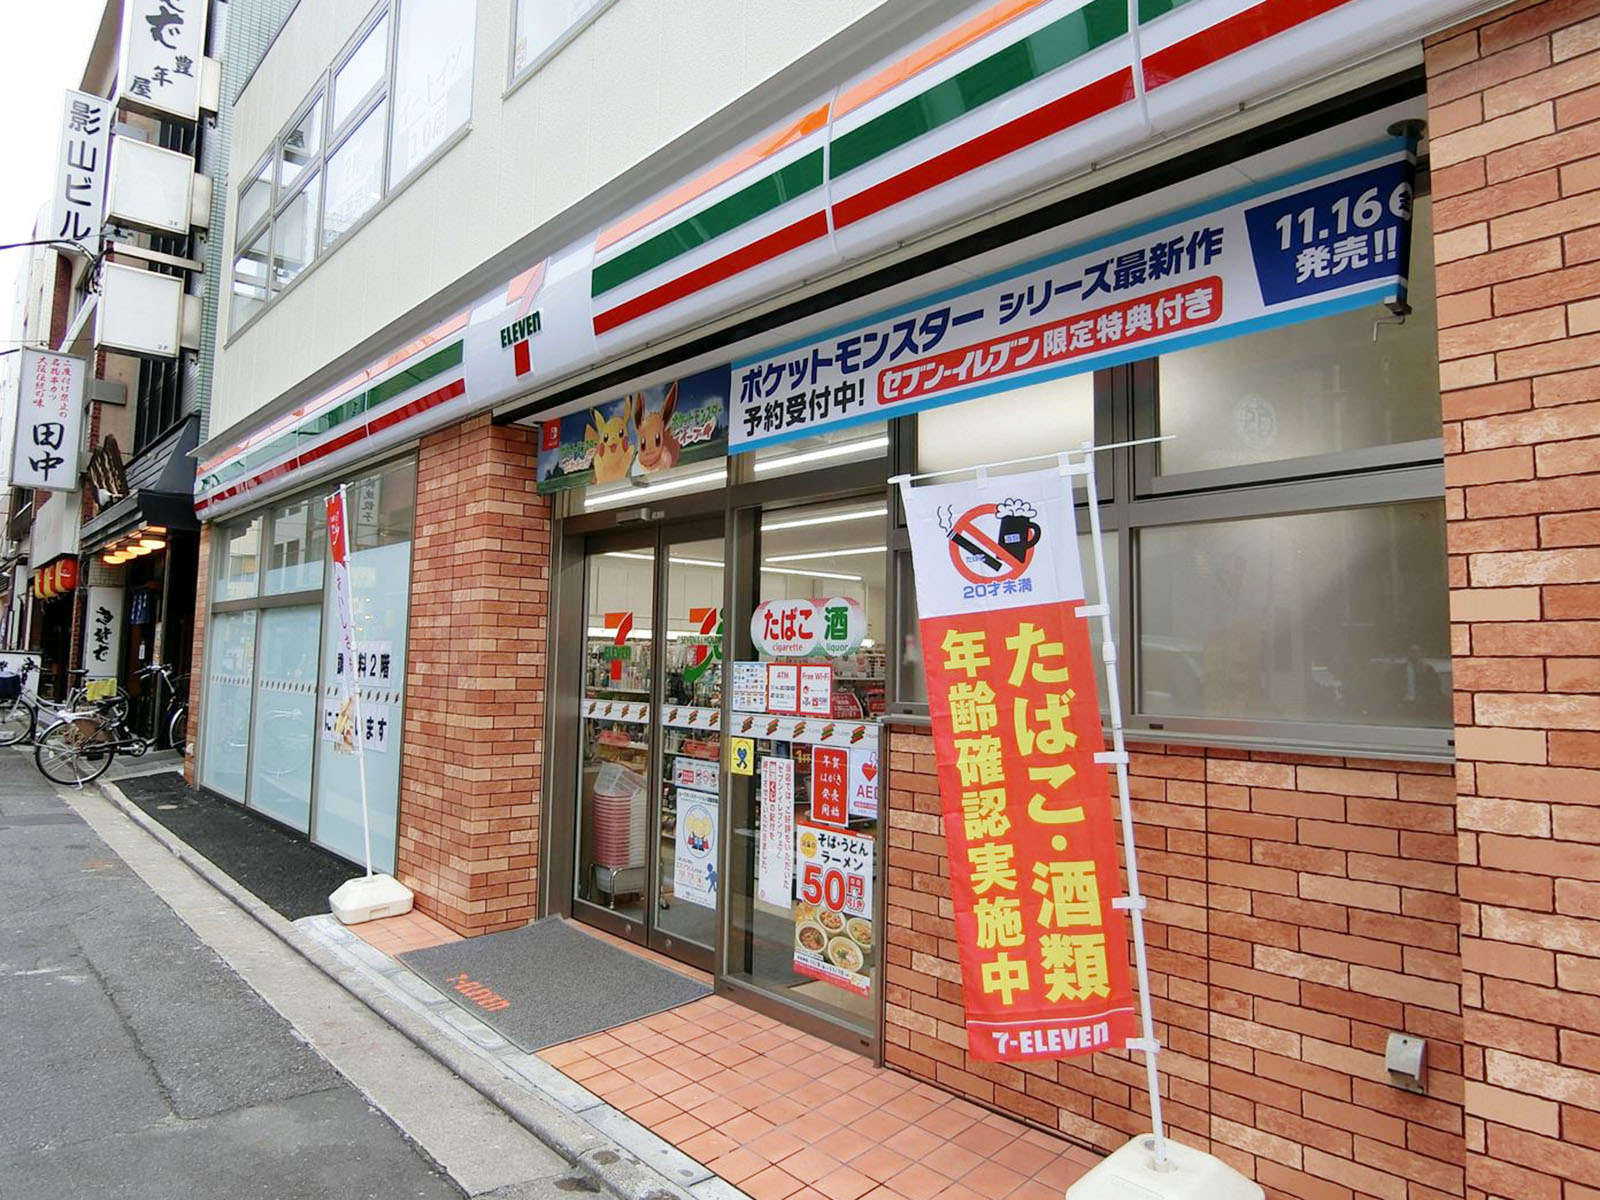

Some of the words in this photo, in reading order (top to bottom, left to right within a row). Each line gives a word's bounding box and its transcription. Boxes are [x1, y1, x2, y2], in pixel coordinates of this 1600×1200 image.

[60, 100, 100, 240] 影山ビル
[740, 307, 984, 404] ポケットモンスター
[999, 227, 1224, 324] シリーズ最新作
[29, 422, 65, 481] 田中
[963, 578, 1032, 599] 20才未満
[764, 607, 814, 641] たばこ
[824, 606, 849, 641] 酒
[772, 642, 804, 653] cigarette
[826, 643, 849, 654] liquor
[777, 671, 790, 679] ATM
[802, 672, 814, 681] Free
[823, 754, 841, 769] 年賀
[821, 787, 841, 803] 発売
[821, 803, 840, 817] 開始
[941, 629, 1030, 1006] 年齢確認実施中
[821, 849, 864, 872] ラーメン
